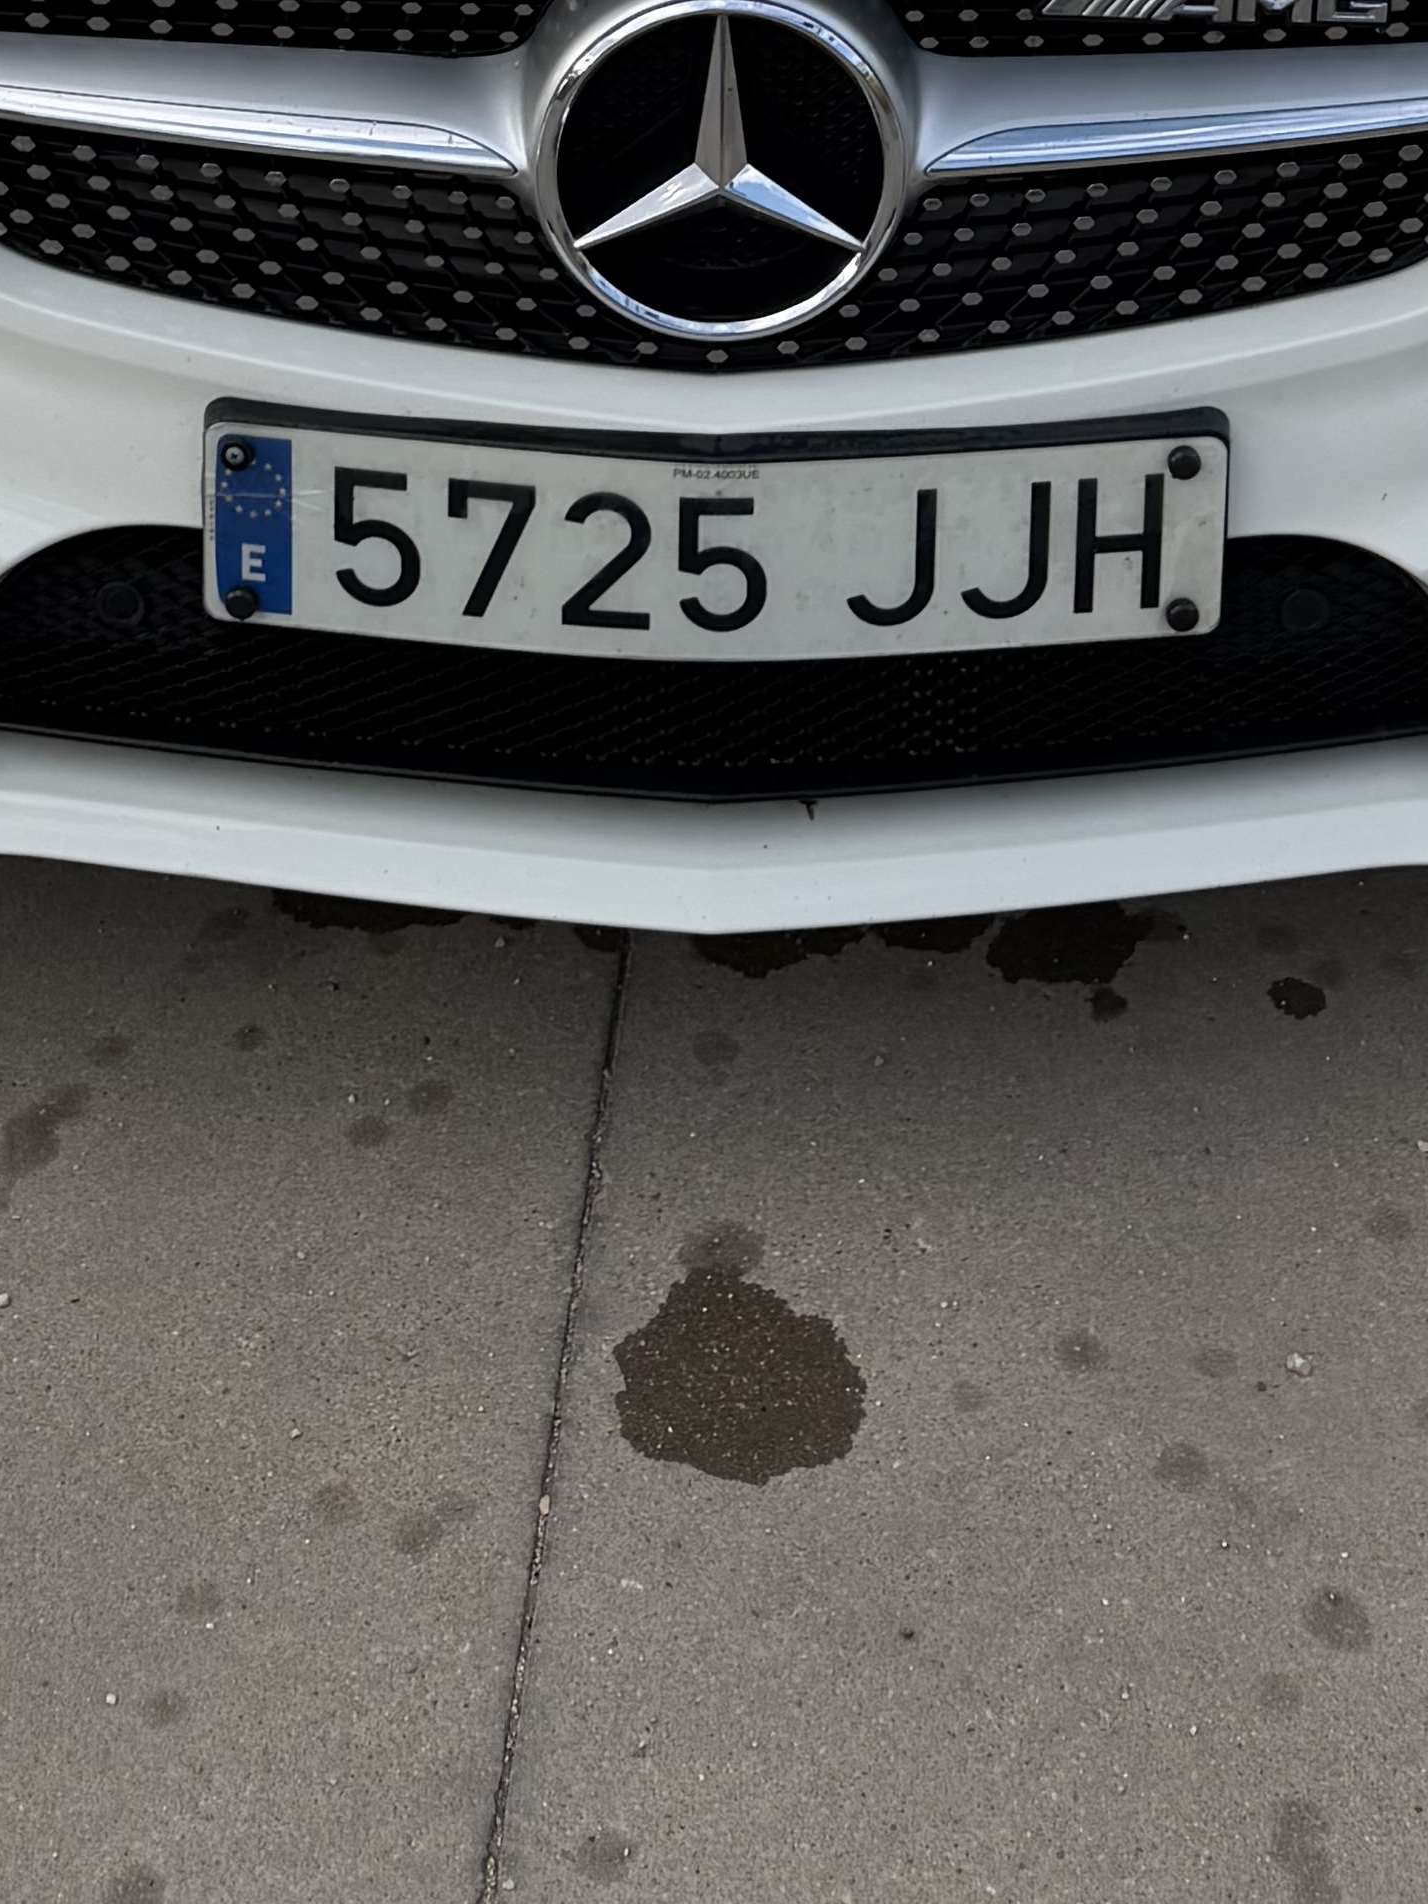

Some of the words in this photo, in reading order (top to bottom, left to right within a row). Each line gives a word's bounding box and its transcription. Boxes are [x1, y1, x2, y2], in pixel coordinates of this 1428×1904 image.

[241, 543, 266, 582] E
[333, 466, 767, 632] 5725
[846, 473, 1165, 626] JJH
